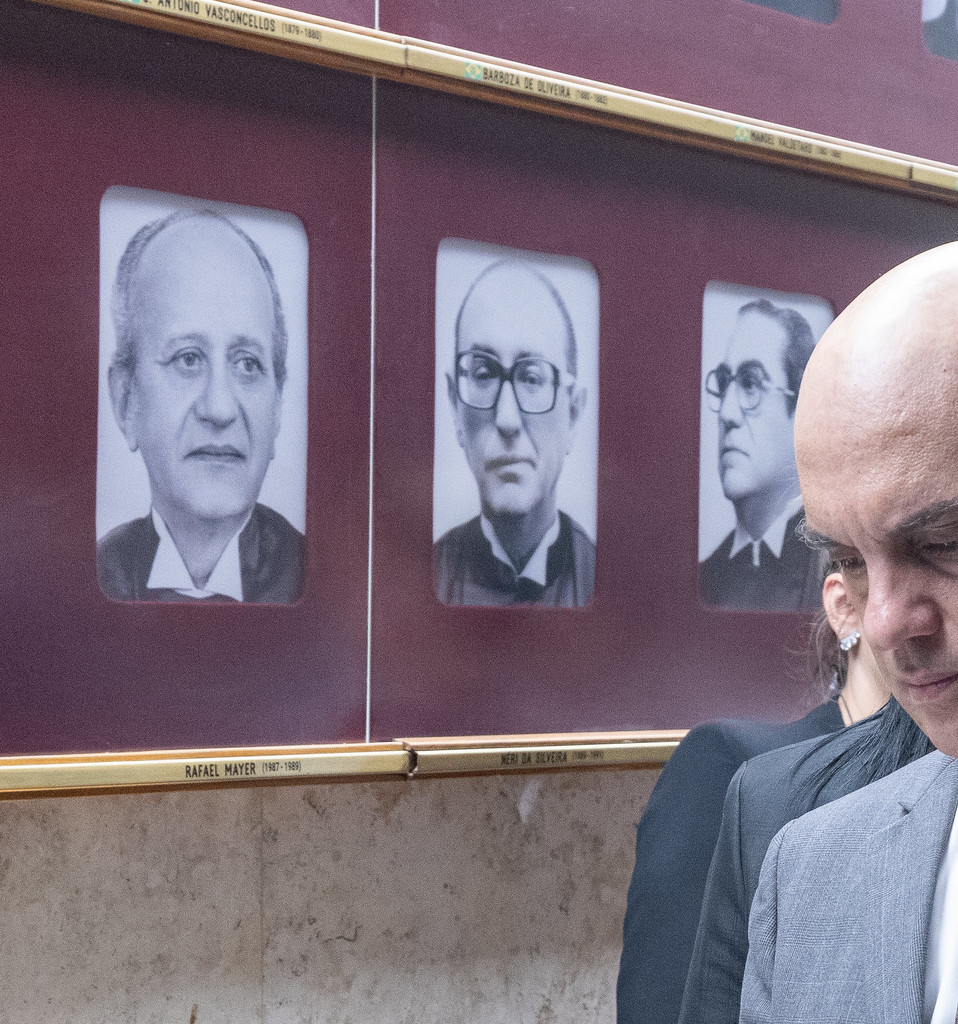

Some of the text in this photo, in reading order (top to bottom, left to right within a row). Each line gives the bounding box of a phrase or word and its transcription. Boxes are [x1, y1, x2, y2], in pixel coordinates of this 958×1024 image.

[205, 4, 275, 31] VASCONCELLOS
[483, 67, 520, 86] BARBOZA
[524, 77, 534, 90] DE
[538, 80, 570, 98] OLIVEIRA
[185, 764, 219, 778] RAFAEL
[225, 762, 256, 776] MAYER
